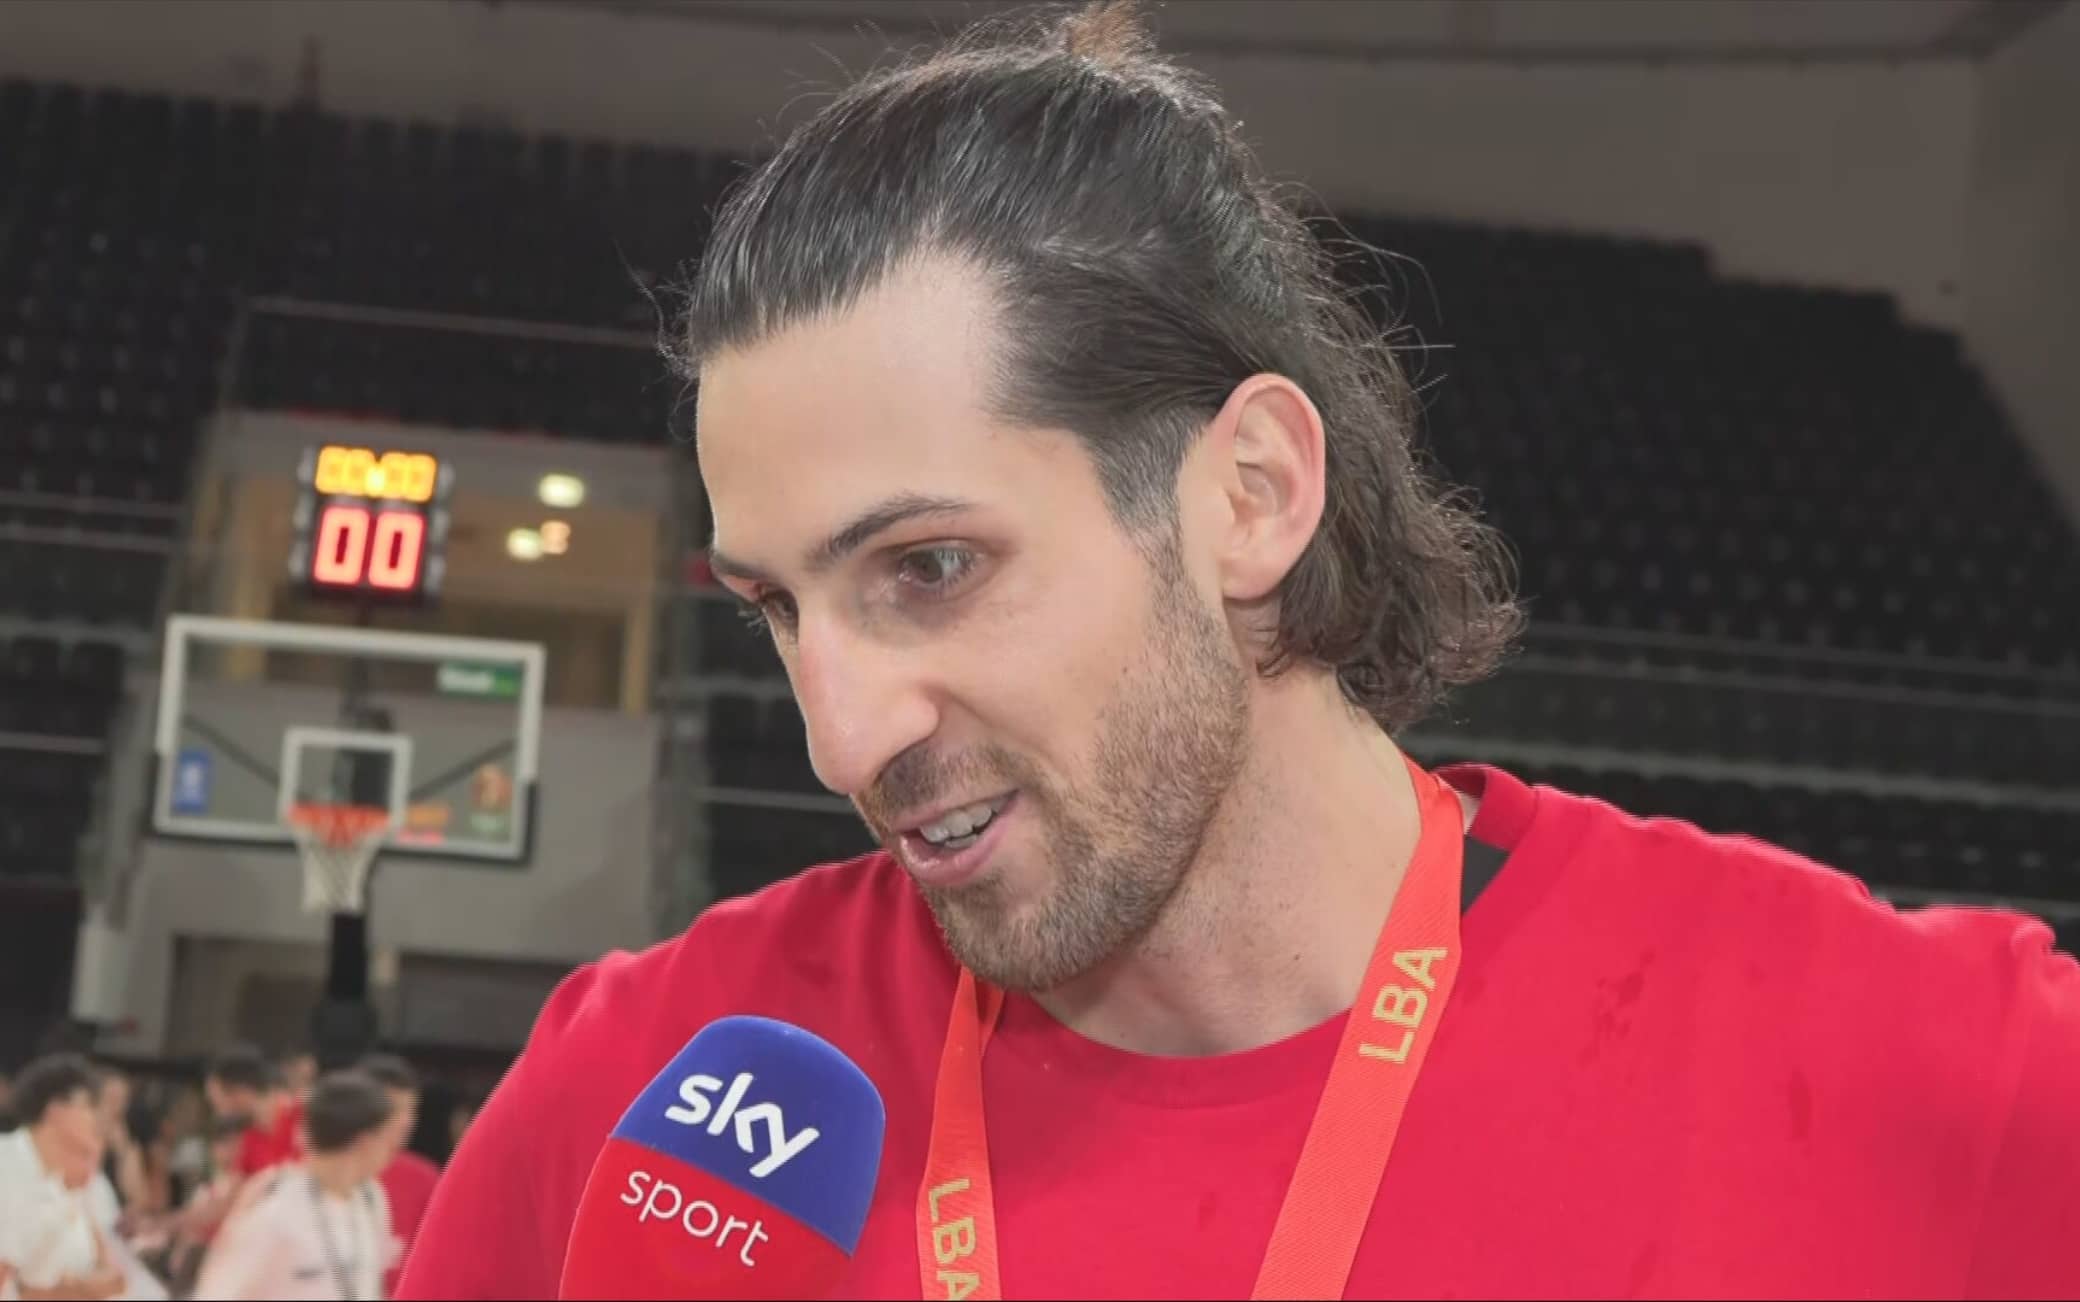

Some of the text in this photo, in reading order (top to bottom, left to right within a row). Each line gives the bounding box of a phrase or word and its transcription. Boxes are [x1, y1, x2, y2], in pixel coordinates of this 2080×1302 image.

[313, 506, 426, 590] 00
[1358, 946, 1448, 1064] LBA
[664, 1072, 820, 1178] sky
[620, 1170, 769, 1266] sport
[928, 1178, 980, 1301] LBA
